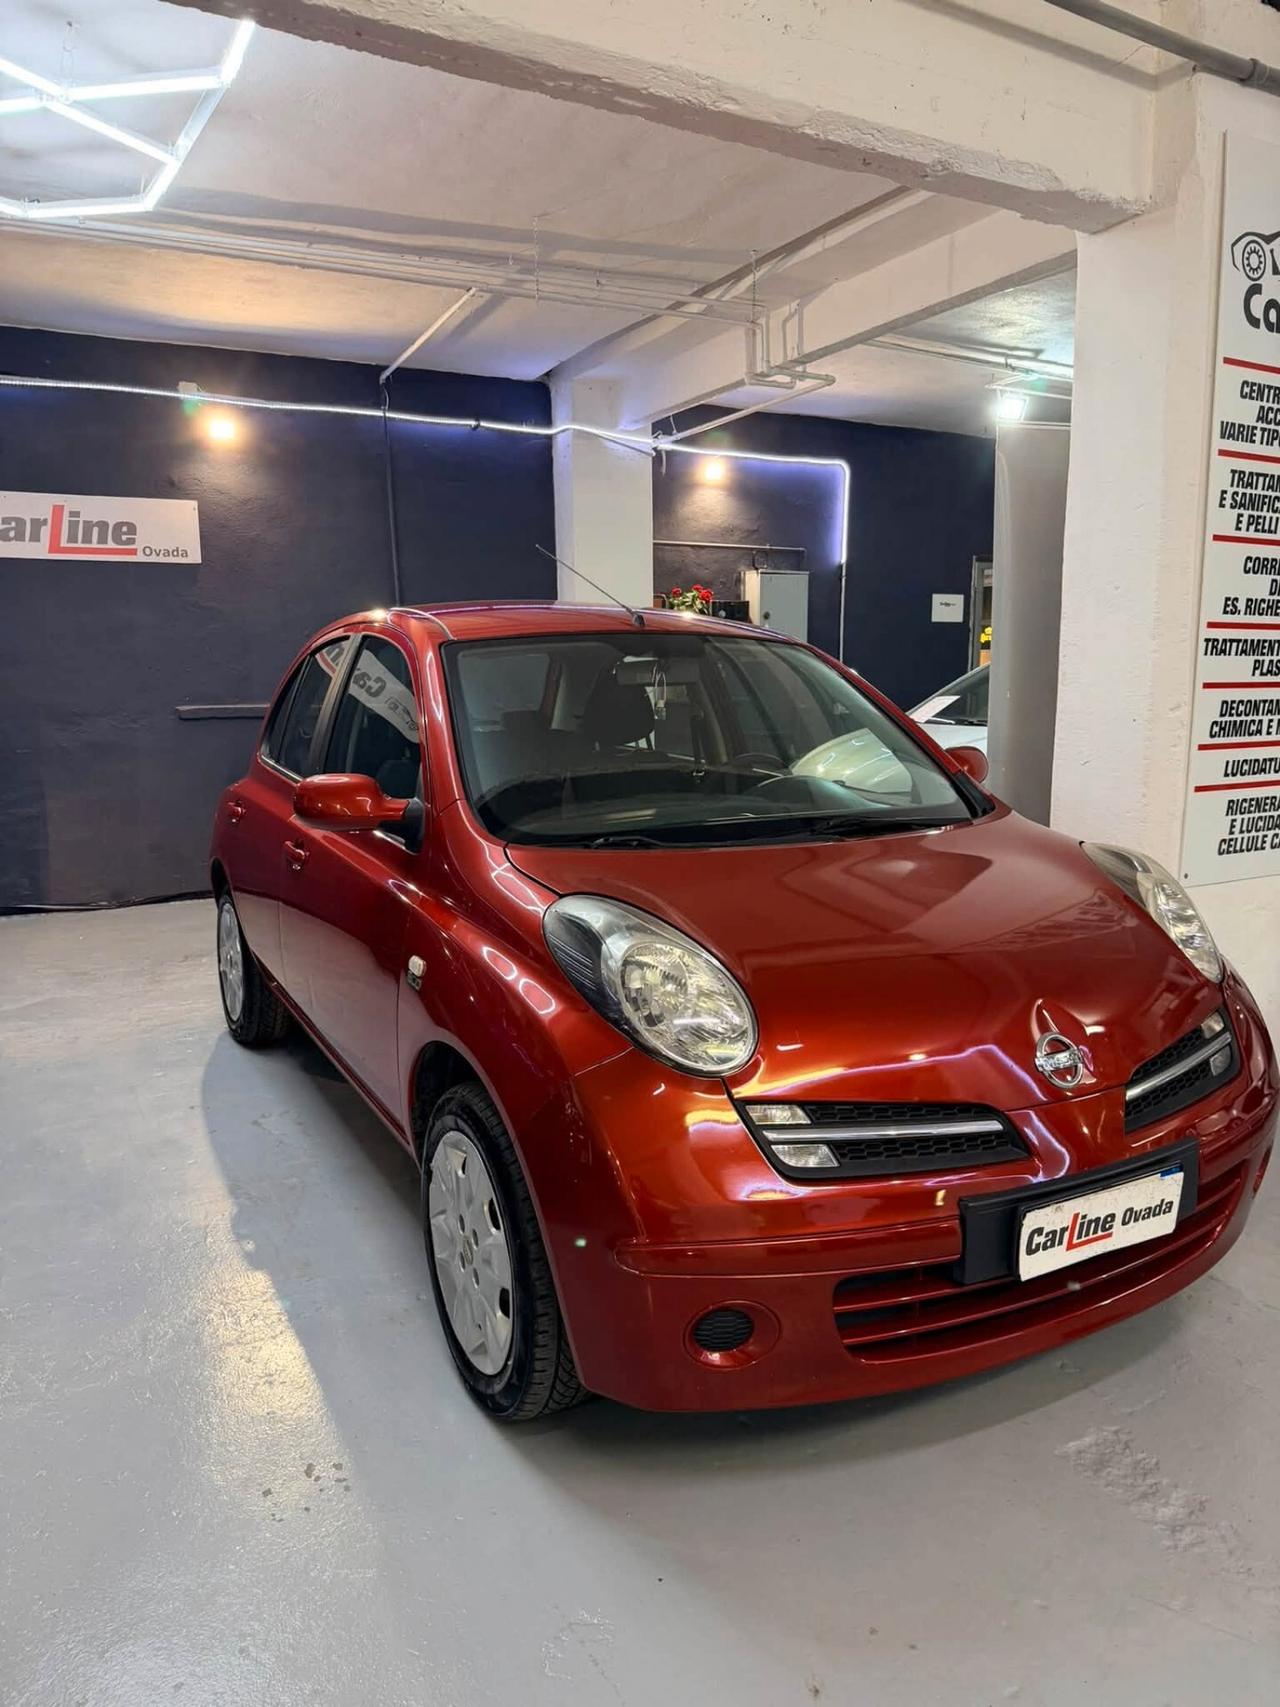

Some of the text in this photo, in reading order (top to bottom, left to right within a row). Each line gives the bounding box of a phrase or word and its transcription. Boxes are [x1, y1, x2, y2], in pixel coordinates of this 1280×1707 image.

[1239, 380, 1280, 405] CENTR
[1256, 405, 1280, 426] ACC
[1220, 420, 1280, 447] VARIE TIP
[1219, 490, 1280, 514] E SANIFIC
[1235, 513, 1280, 534] E PELLI
[142, 546, 189, 558] Ovada
[1252, 659, 1280, 676] PLAS
[1209, 718, 1263, 738] CHIMICA
[1266, 718, 1274, 736] E
[1229, 818, 1237, 835] E
[1218, 834, 1268, 855] CELLULE
[1026, 1199, 1174, 1256] CarLine Ovada
